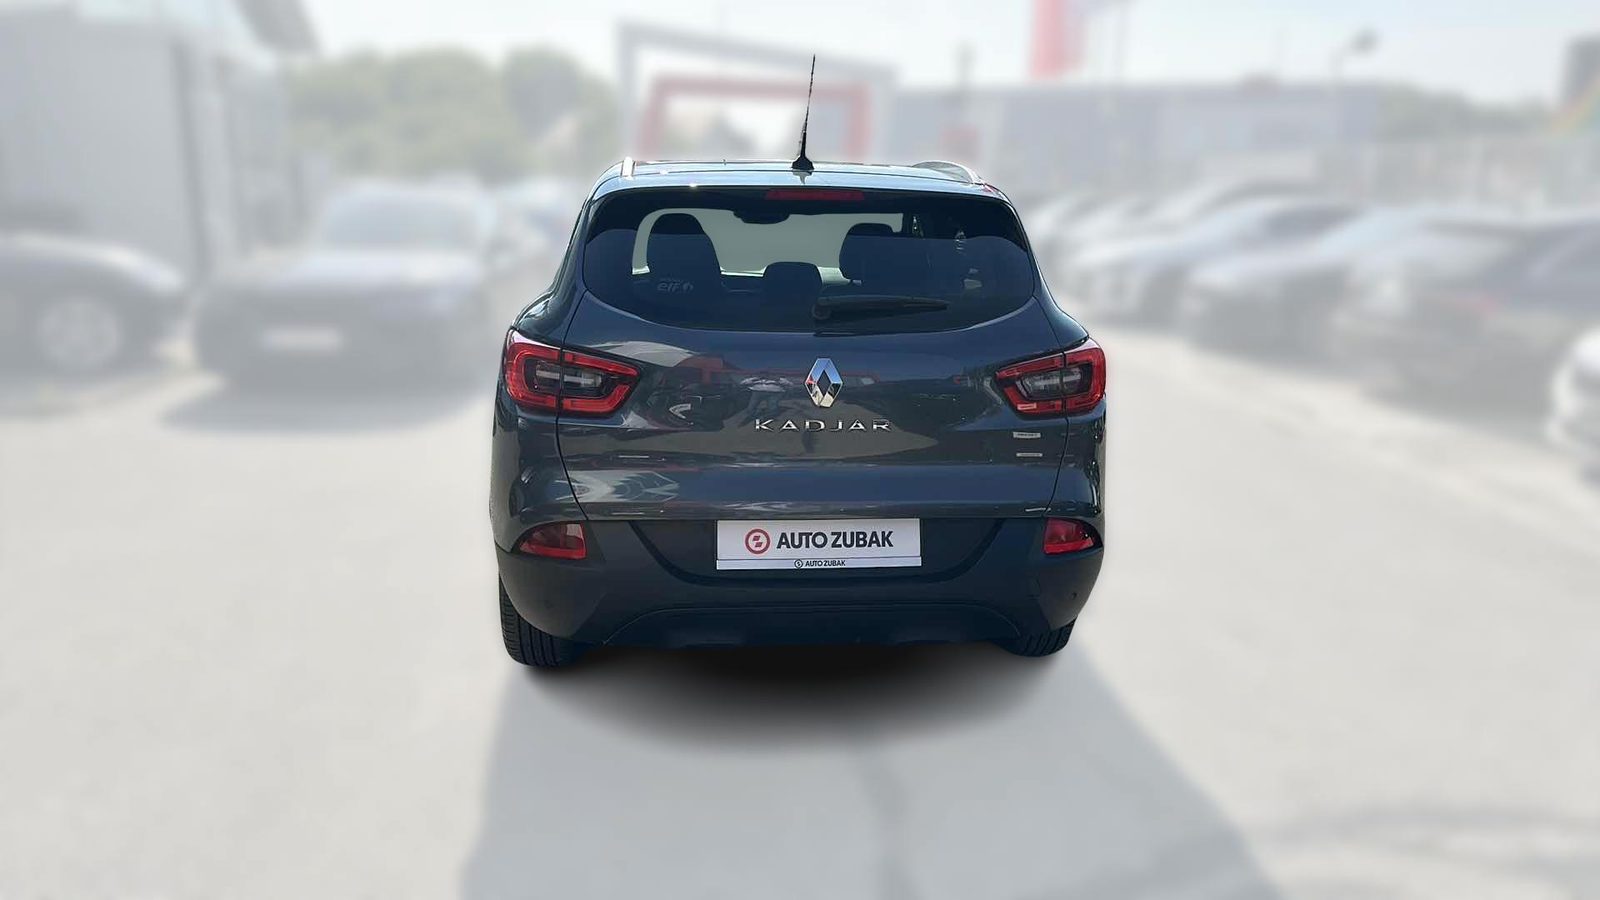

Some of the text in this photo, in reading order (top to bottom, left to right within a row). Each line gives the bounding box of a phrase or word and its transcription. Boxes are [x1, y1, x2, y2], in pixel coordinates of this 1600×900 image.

[755, 418, 892, 432] KADJAR
[776, 530, 894, 549] AUTO ZUBAK
[823, 559, 846, 567] ZUBAK
